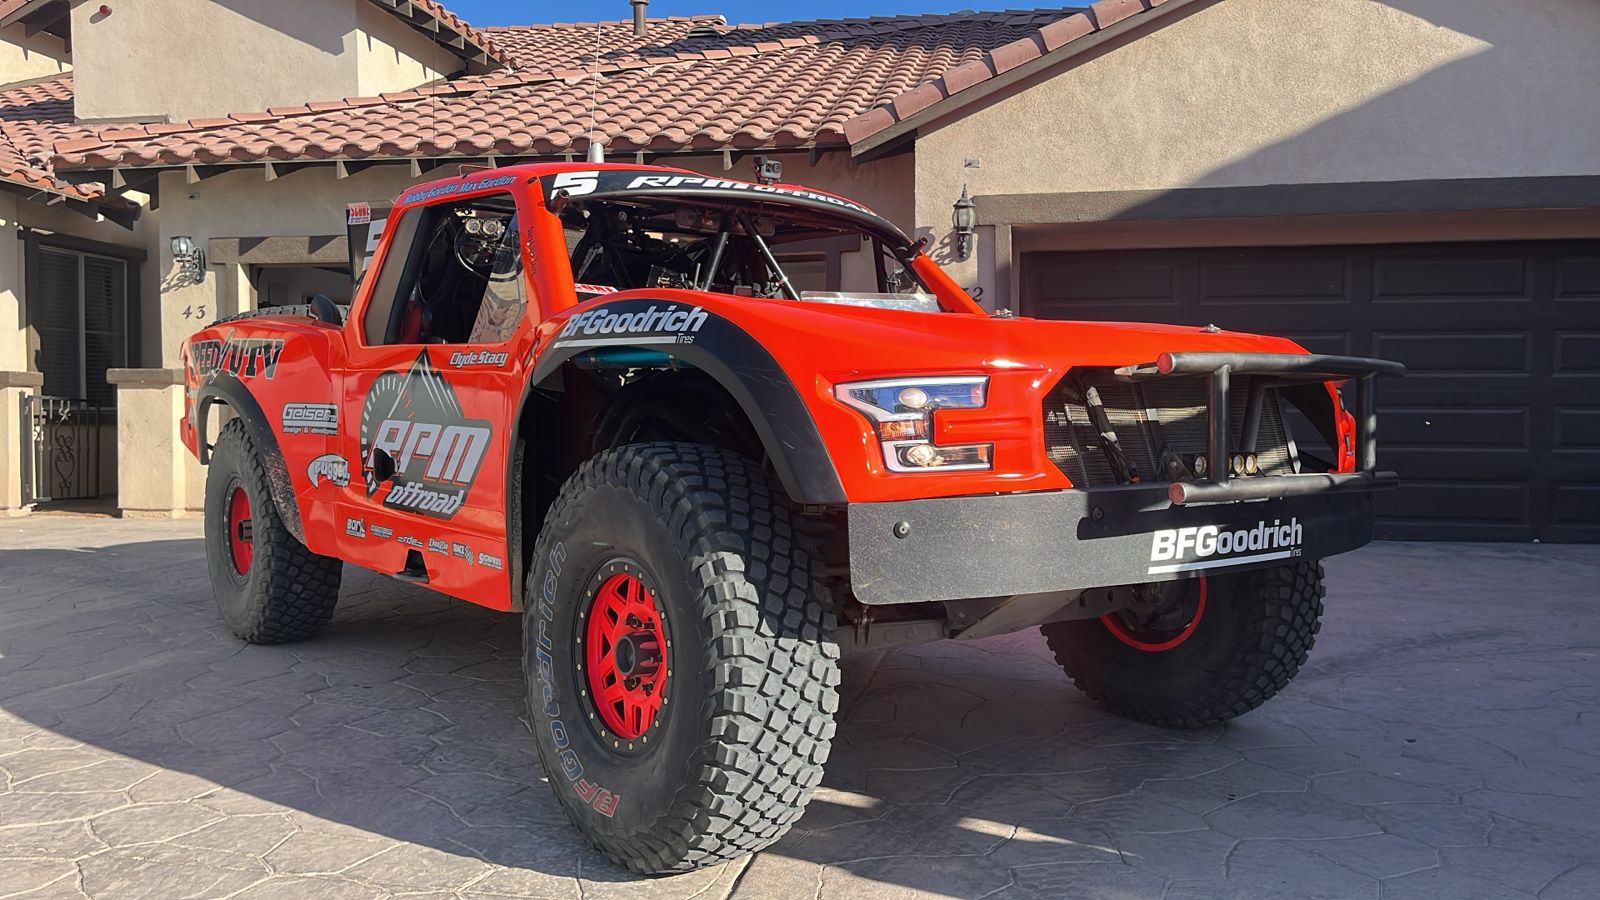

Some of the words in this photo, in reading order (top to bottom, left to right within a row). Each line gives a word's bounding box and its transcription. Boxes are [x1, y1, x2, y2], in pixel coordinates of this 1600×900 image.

[428, 184, 458, 198] Gordon
[459, 182, 478, 194] Max
[480, 175, 518, 189] Gordon
[551, 171, 599, 200] 5
[626, 175, 750, 191] RPM
[182, 304, 206, 320] 43
[559, 305, 709, 339] BFGoodrich
[676, 332, 695, 344] Tires
[450, 352, 479, 368] Clyde
[478, 351, 509, 367] Stacy
[366, 419, 490, 483] RPM
[314, 461, 348, 481] rugged
[386, 481, 465, 515] offroad
[1151, 517, 1303, 562] BFGoodrich
